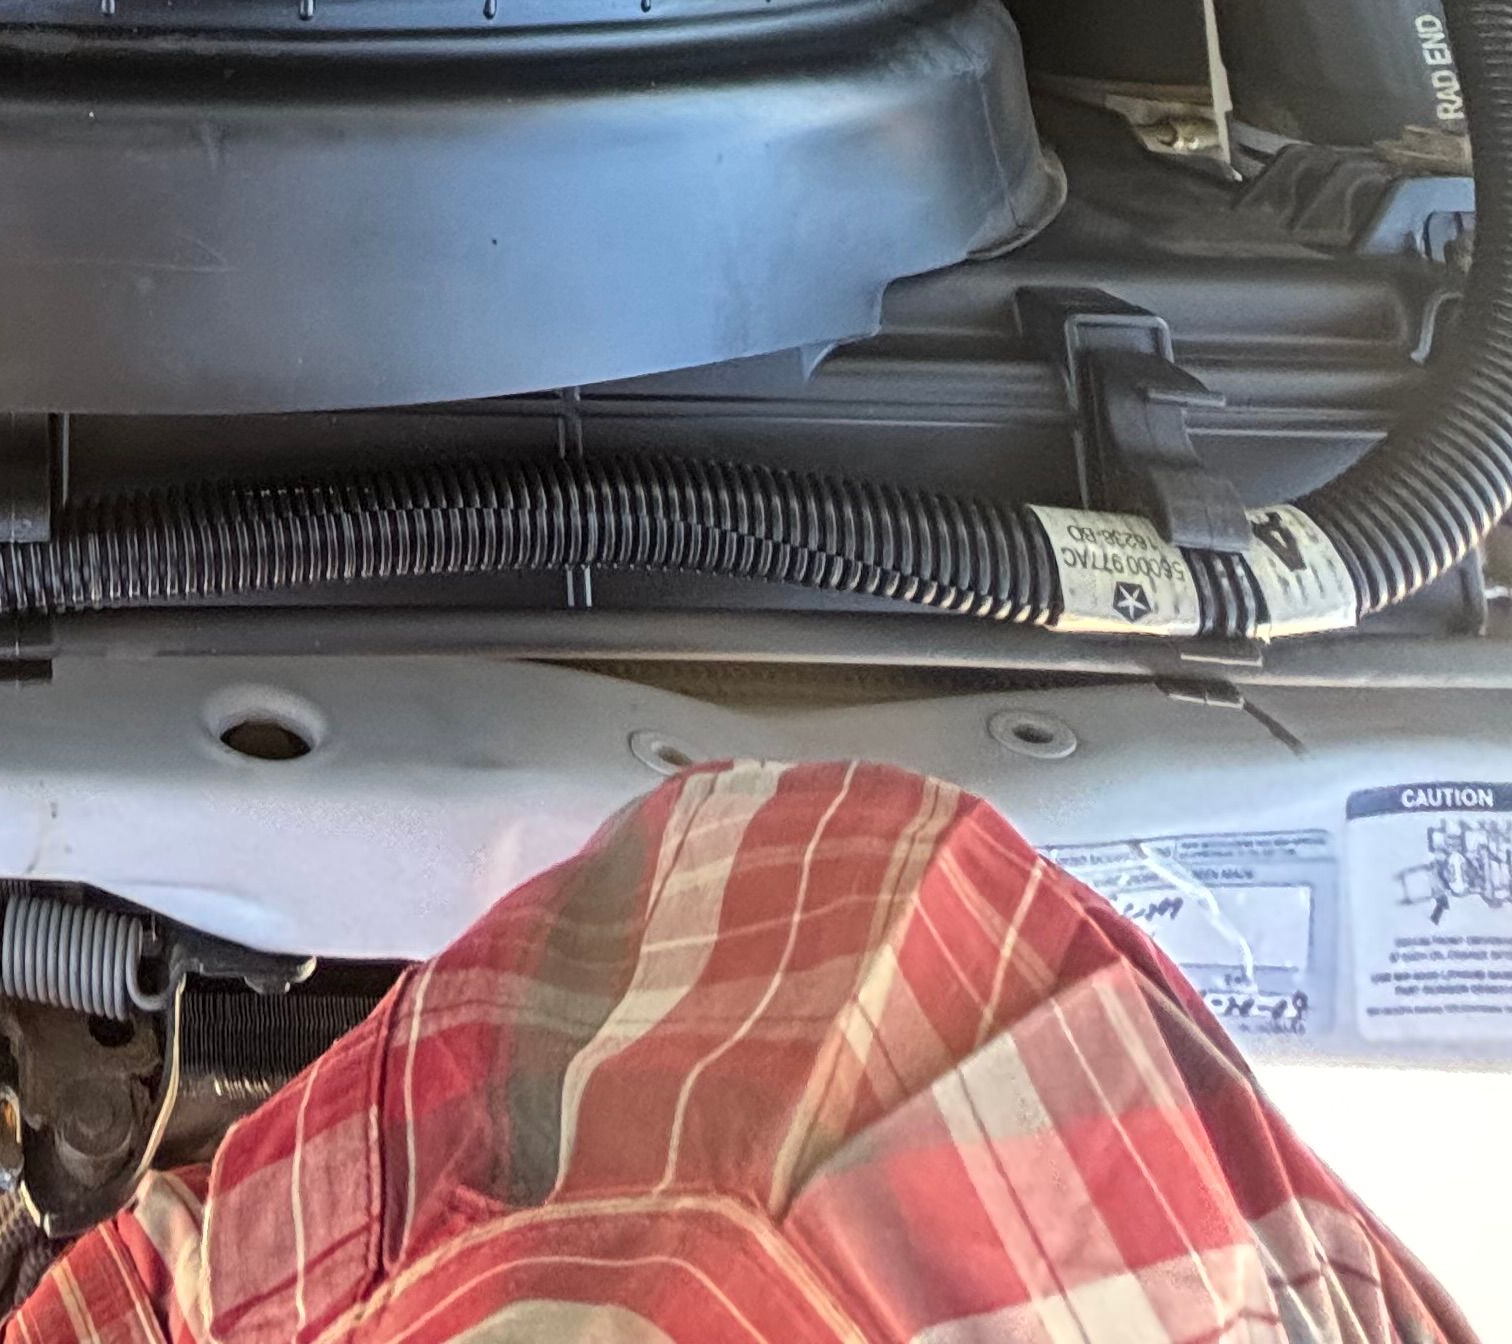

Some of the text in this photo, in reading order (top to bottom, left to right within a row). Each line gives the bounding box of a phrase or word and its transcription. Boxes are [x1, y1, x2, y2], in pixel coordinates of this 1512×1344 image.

[1415, 14, 1465, 120] RAD END
[1401, 788, 1494, 808] CAUTION
